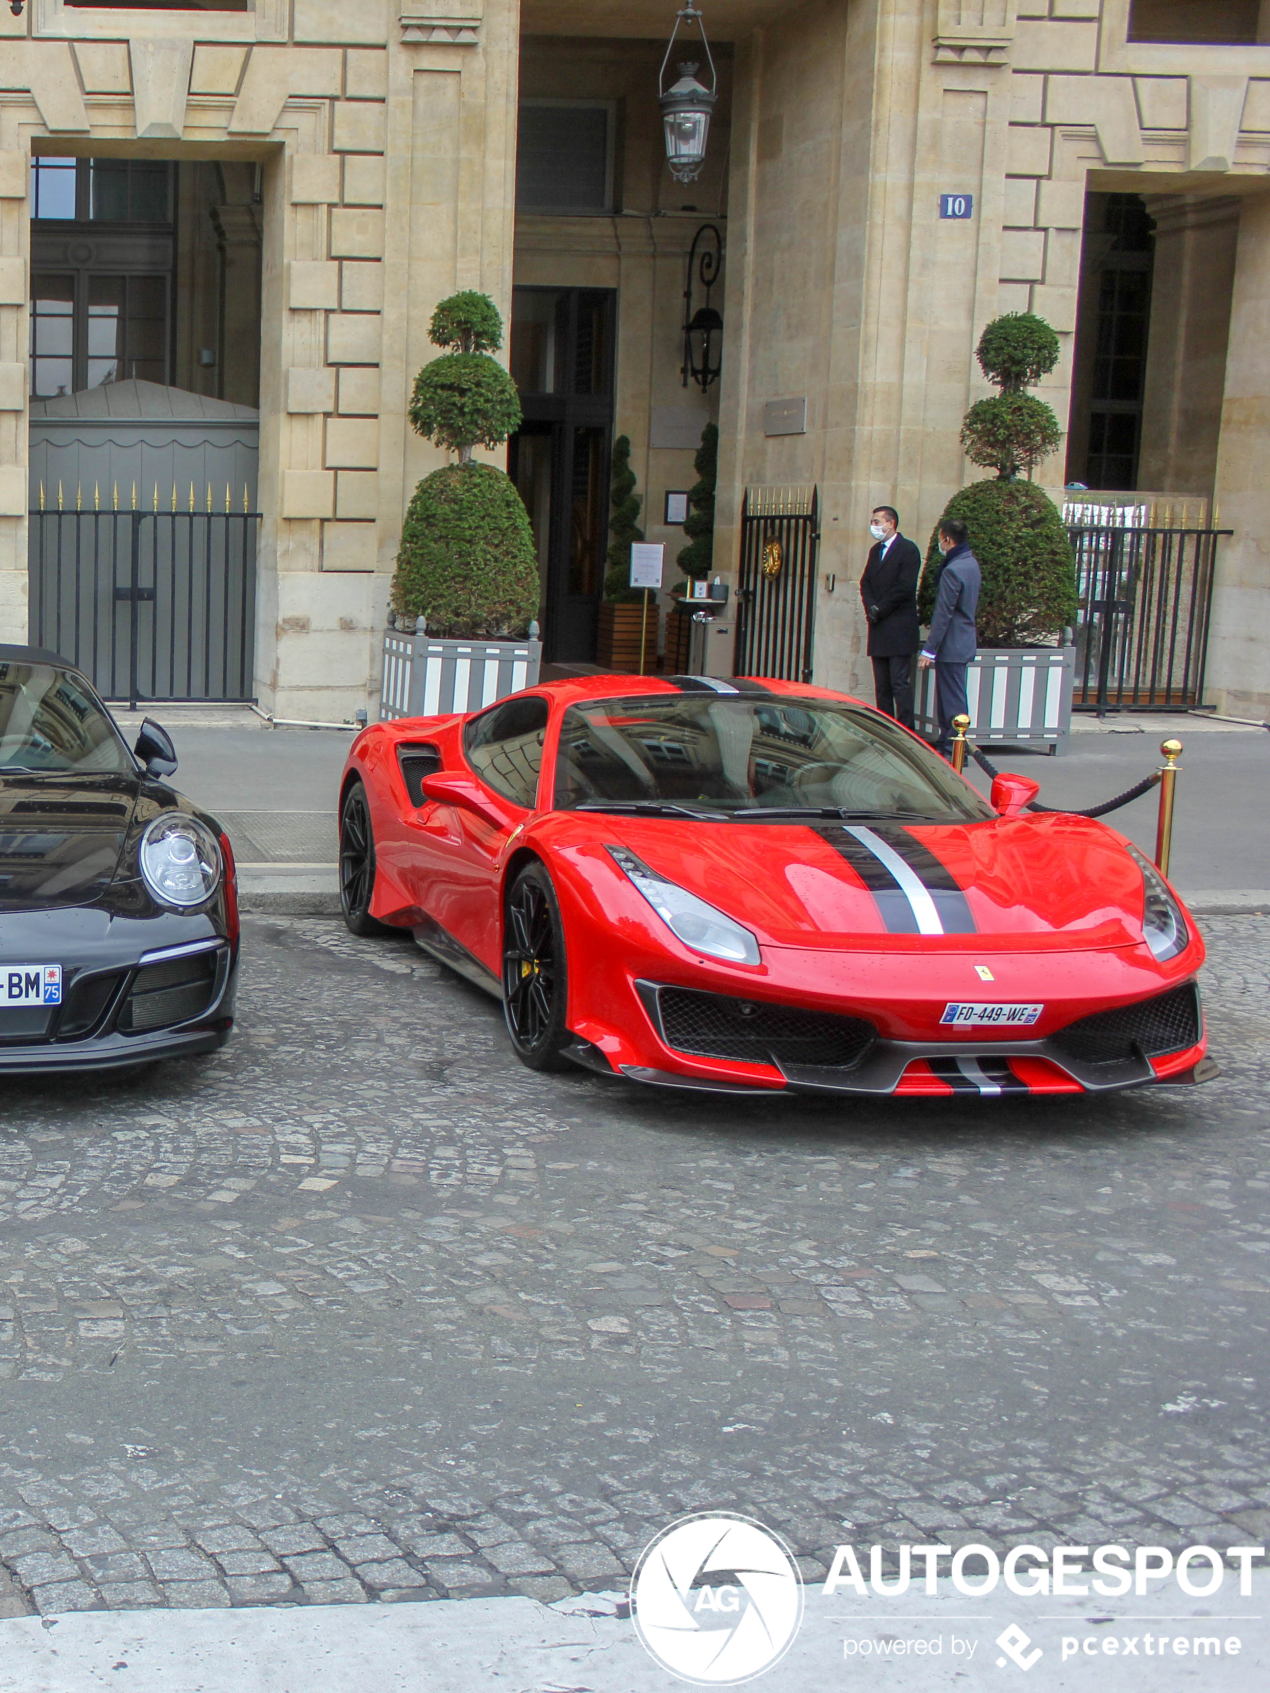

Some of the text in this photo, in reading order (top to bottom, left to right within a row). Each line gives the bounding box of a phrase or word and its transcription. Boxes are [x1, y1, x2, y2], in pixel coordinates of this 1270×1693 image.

[946, 197, 966, 216] 10
[44, 985, 60, 999] 75
[956, 1006, 1029, 1022] FD-449-WE
